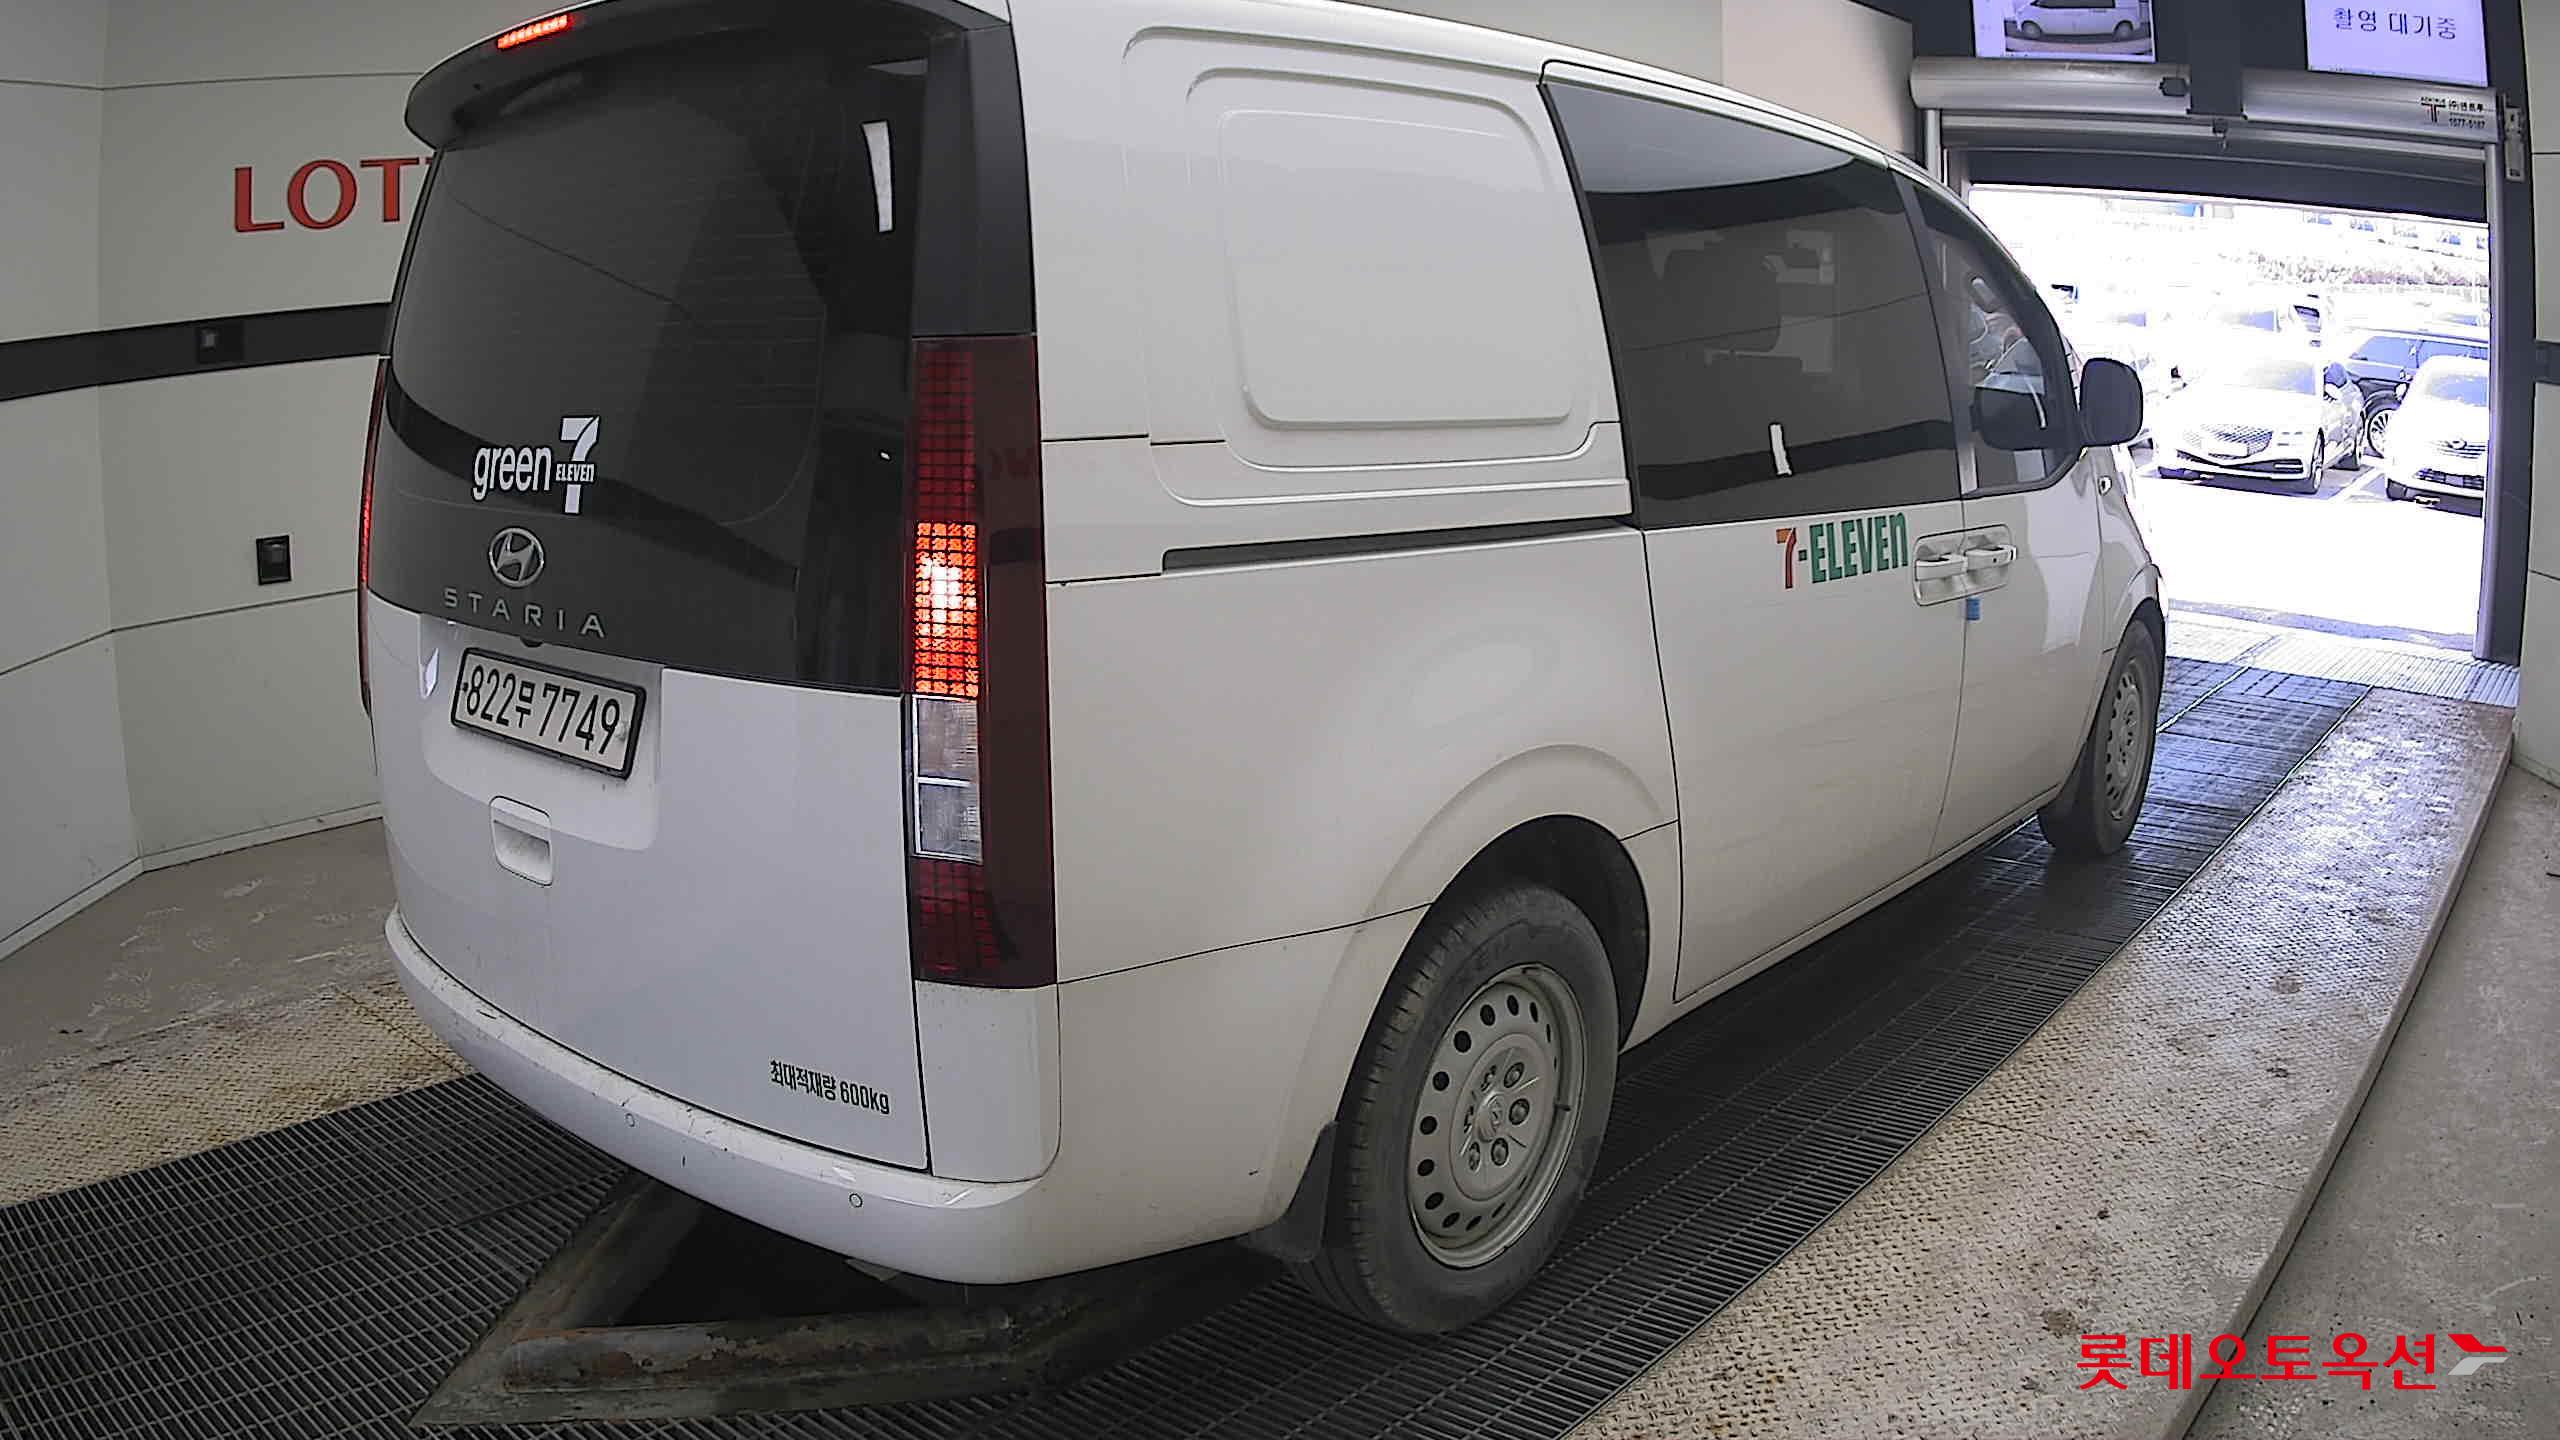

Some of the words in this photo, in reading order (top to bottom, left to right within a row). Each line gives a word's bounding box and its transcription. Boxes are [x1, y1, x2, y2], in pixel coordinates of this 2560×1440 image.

[2334, 7, 2377, 32] 촬영
[2389, 12, 2457, 40] 대기중
[234, 157, 433, 233] LOT
[472, 446, 552, 501] green
[555, 463, 595, 483] ELEVEN
[1775, 512, 1909, 589] 7-ELEVEN
[444, 587, 605, 638] STARIA
[770, 1059, 837, 1101] 최대적재량
[839, 1081, 890, 1115] 600kg
